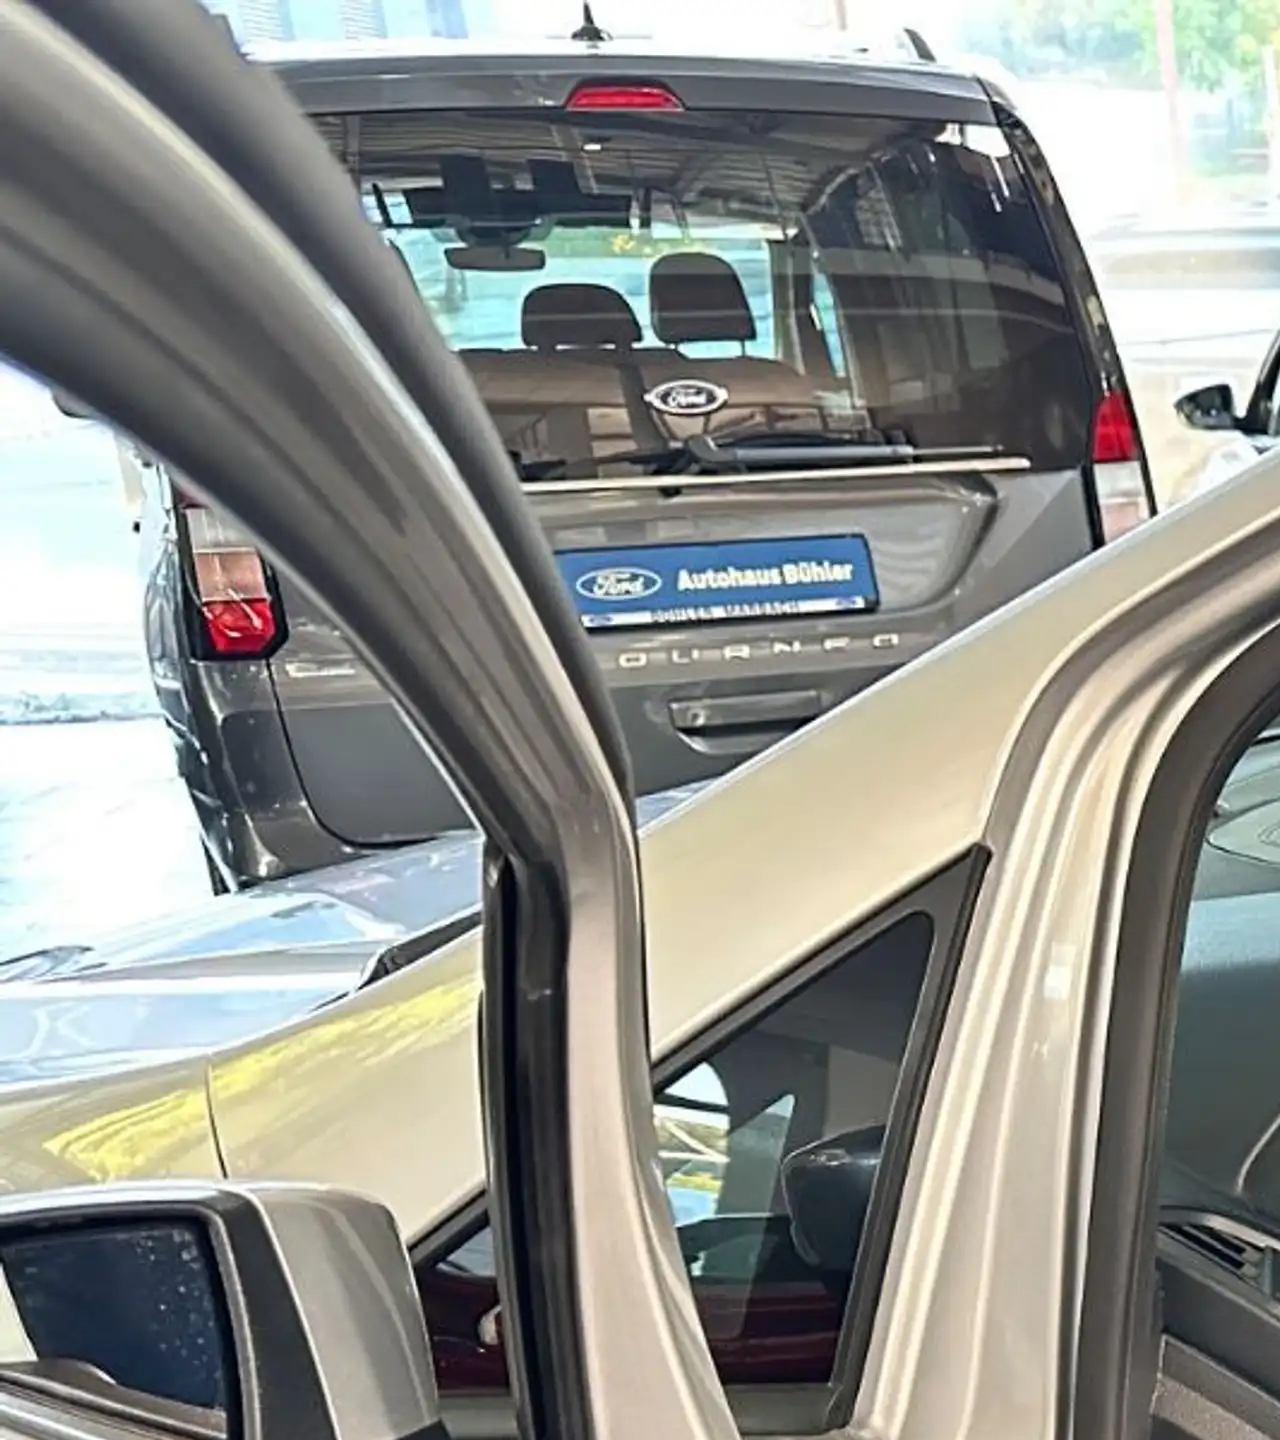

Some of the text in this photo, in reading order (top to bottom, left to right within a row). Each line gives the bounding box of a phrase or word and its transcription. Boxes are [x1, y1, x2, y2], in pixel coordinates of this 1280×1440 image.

[667, 387, 707, 408] Ford
[592, 571, 646, 597] Ford
[676, 560, 853, 591] Autohaus Bühler
